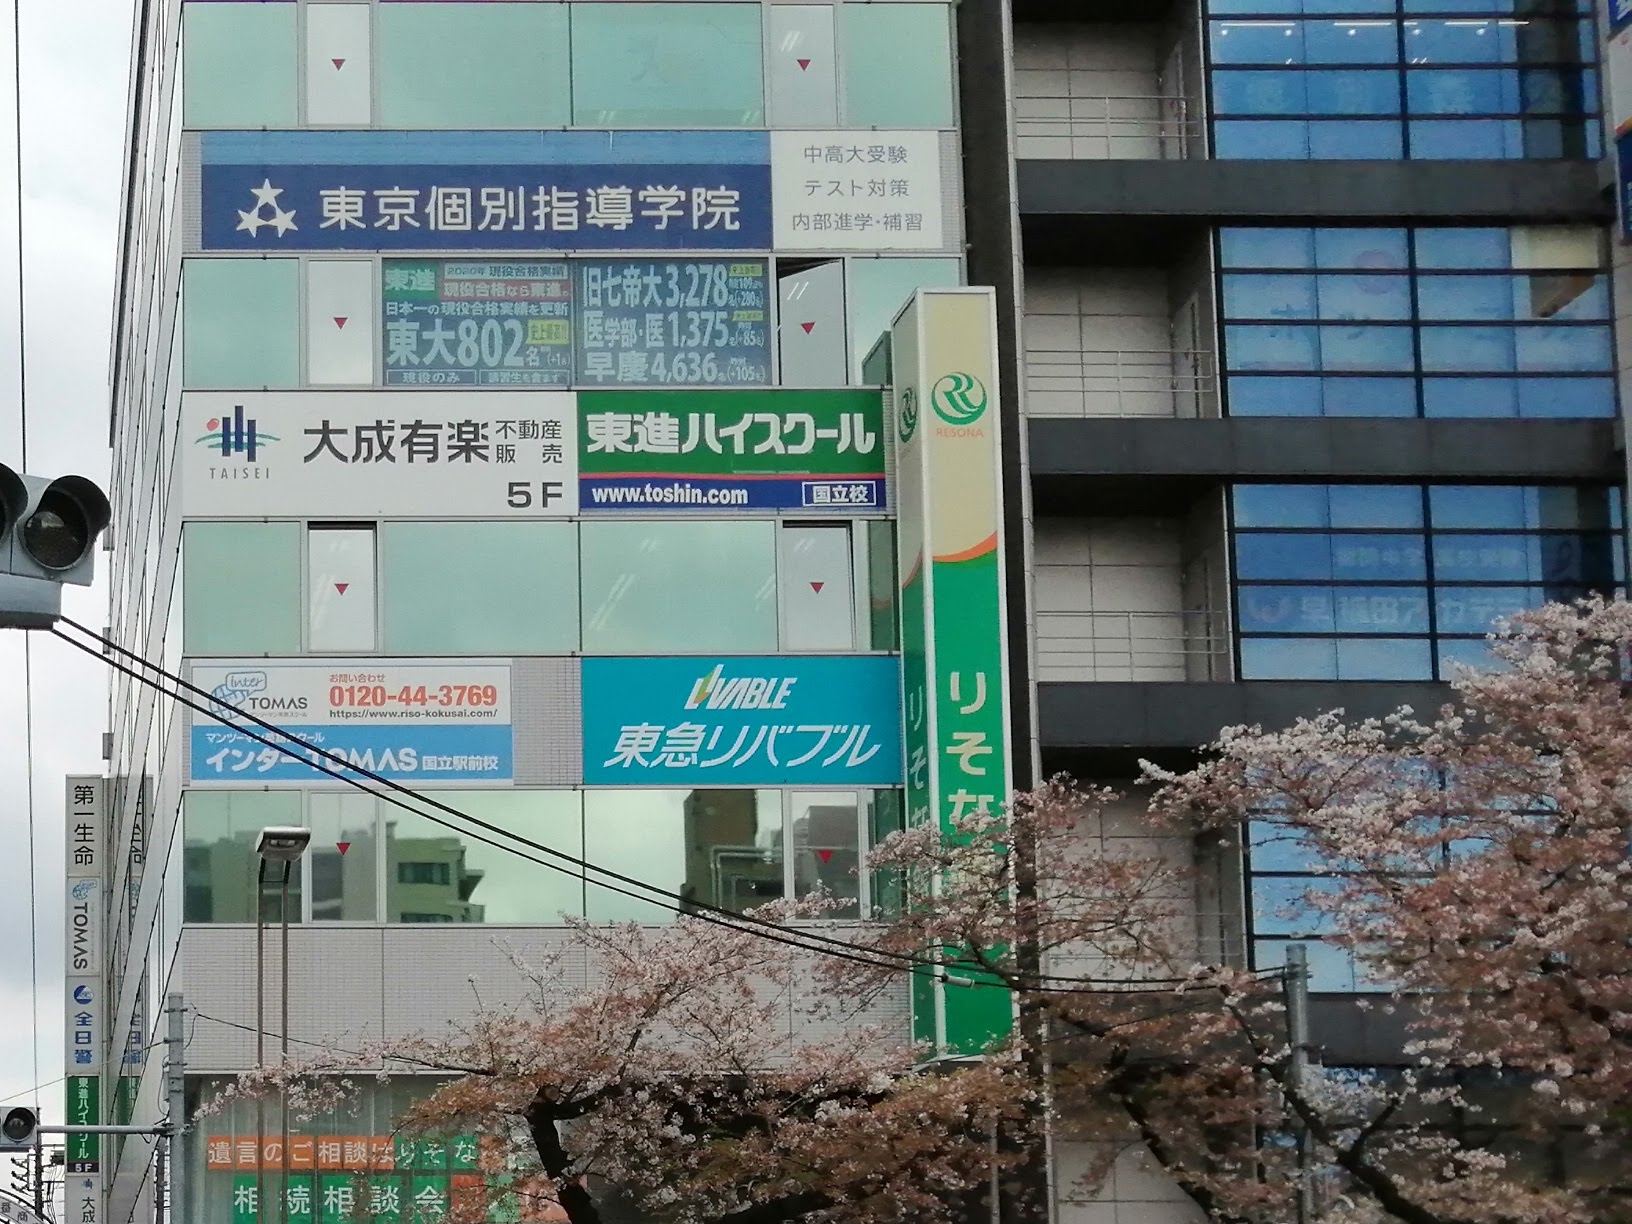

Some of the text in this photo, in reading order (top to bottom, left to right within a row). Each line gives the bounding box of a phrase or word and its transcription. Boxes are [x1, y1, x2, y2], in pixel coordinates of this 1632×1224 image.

[803, 145, 909, 165] 中高大受験
[804, 178, 911, 198] テスト対策
[317, 184, 742, 233] 東京個別指導学院
[791, 213, 923, 234] 内部進学・補習
[384, 268, 436, 292] 東進
[402, 371, 461, 384] 現役のみ
[495, 418, 563, 441] 不動産
[585, 412, 876, 455] 東進ハイスクール
[935, 428, 985, 439] RESONA
[303, 418, 490, 464] 大成有楽
[209, 467, 270, 480] TAISEI
[591, 482, 749, 505] www.toshin.com
[812, 484, 869, 503] 国立校
[329, 673, 386, 684] お問い合わせ
[248, 697, 309, 710] TOMAS
[329, 685, 498, 708] 0120-44-3769
[329, 708, 498, 720] https://www.riso-kokusai.com/
[603, 721, 883, 769] 東急リバブル
[422, 754, 499, 772] 国立駅前校
[73, 784, 95, 866] 第一生命
[73, 902, 89, 970] TOMAS
[75, 1163, 93, 1173] 5F
[233, 1184, 447, 1216] 相続相談会
